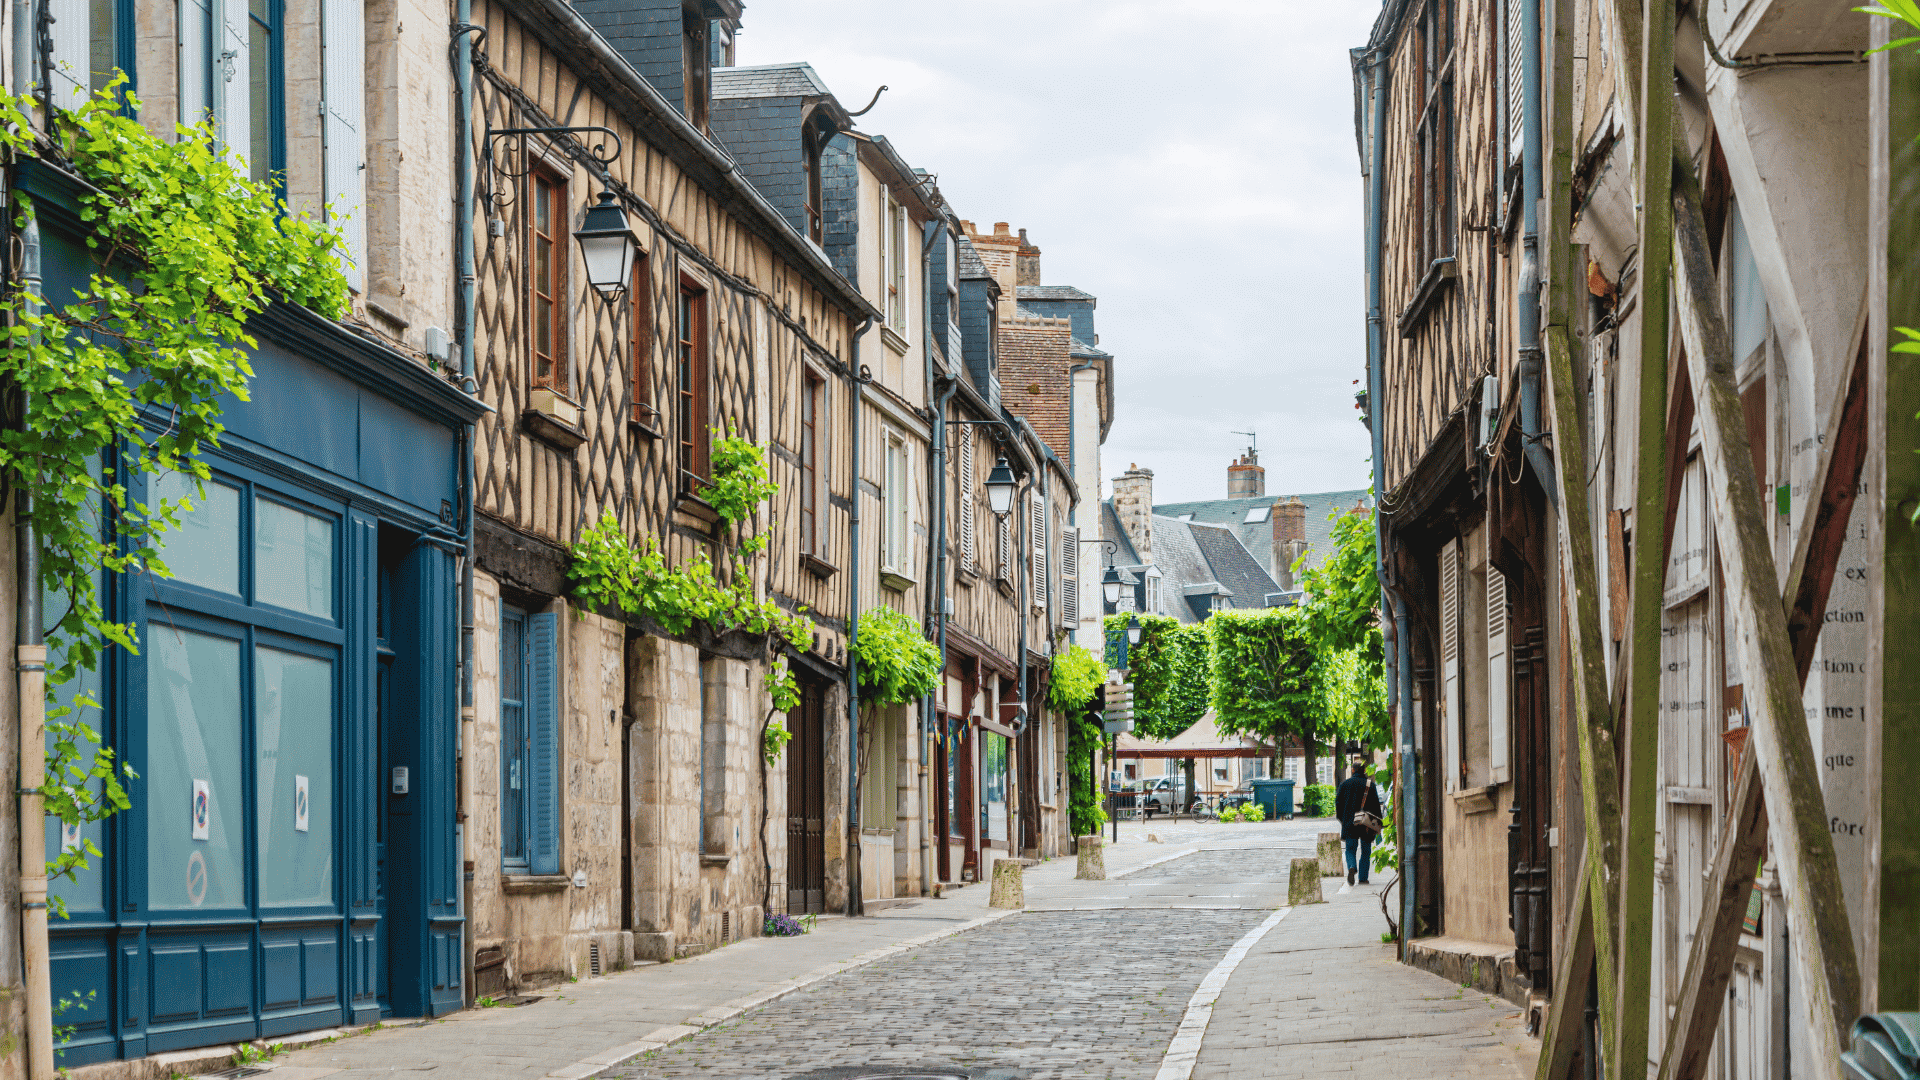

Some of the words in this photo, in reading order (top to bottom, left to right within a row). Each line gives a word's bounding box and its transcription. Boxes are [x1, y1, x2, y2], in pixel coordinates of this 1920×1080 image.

[1846, 567, 1866, 580] ex
[1825, 608, 1865, 622] ction
[1825, 755, 1854, 771] que
